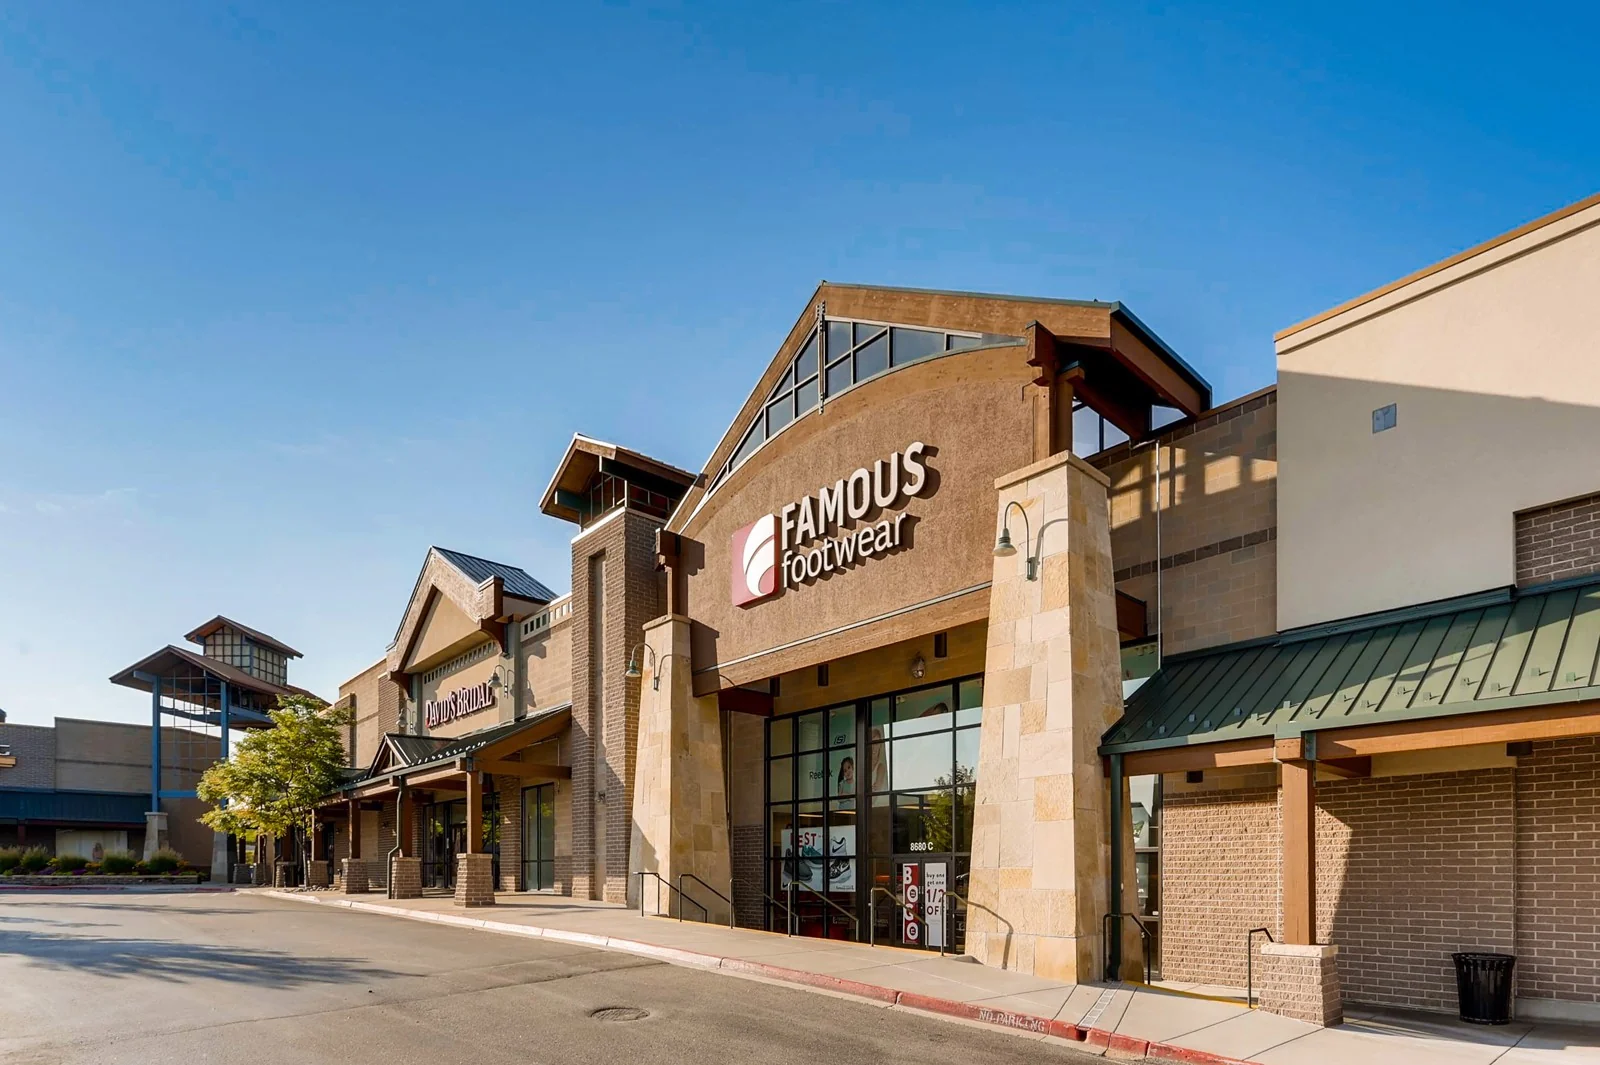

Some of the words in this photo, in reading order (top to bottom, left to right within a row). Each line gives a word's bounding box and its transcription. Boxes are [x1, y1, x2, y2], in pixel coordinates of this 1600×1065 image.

[781, 441, 926, 550] FAMOUS
[781, 512, 907, 588] footwear
[425, 691, 456, 728] DAVID'S
[456, 683, 494, 717] BRIDAL
[910, 842, 926, 851] 8680
[927, 842, 934, 850] C
[926, 872, 935, 880] buy
[926, 905, 944, 916] OF
